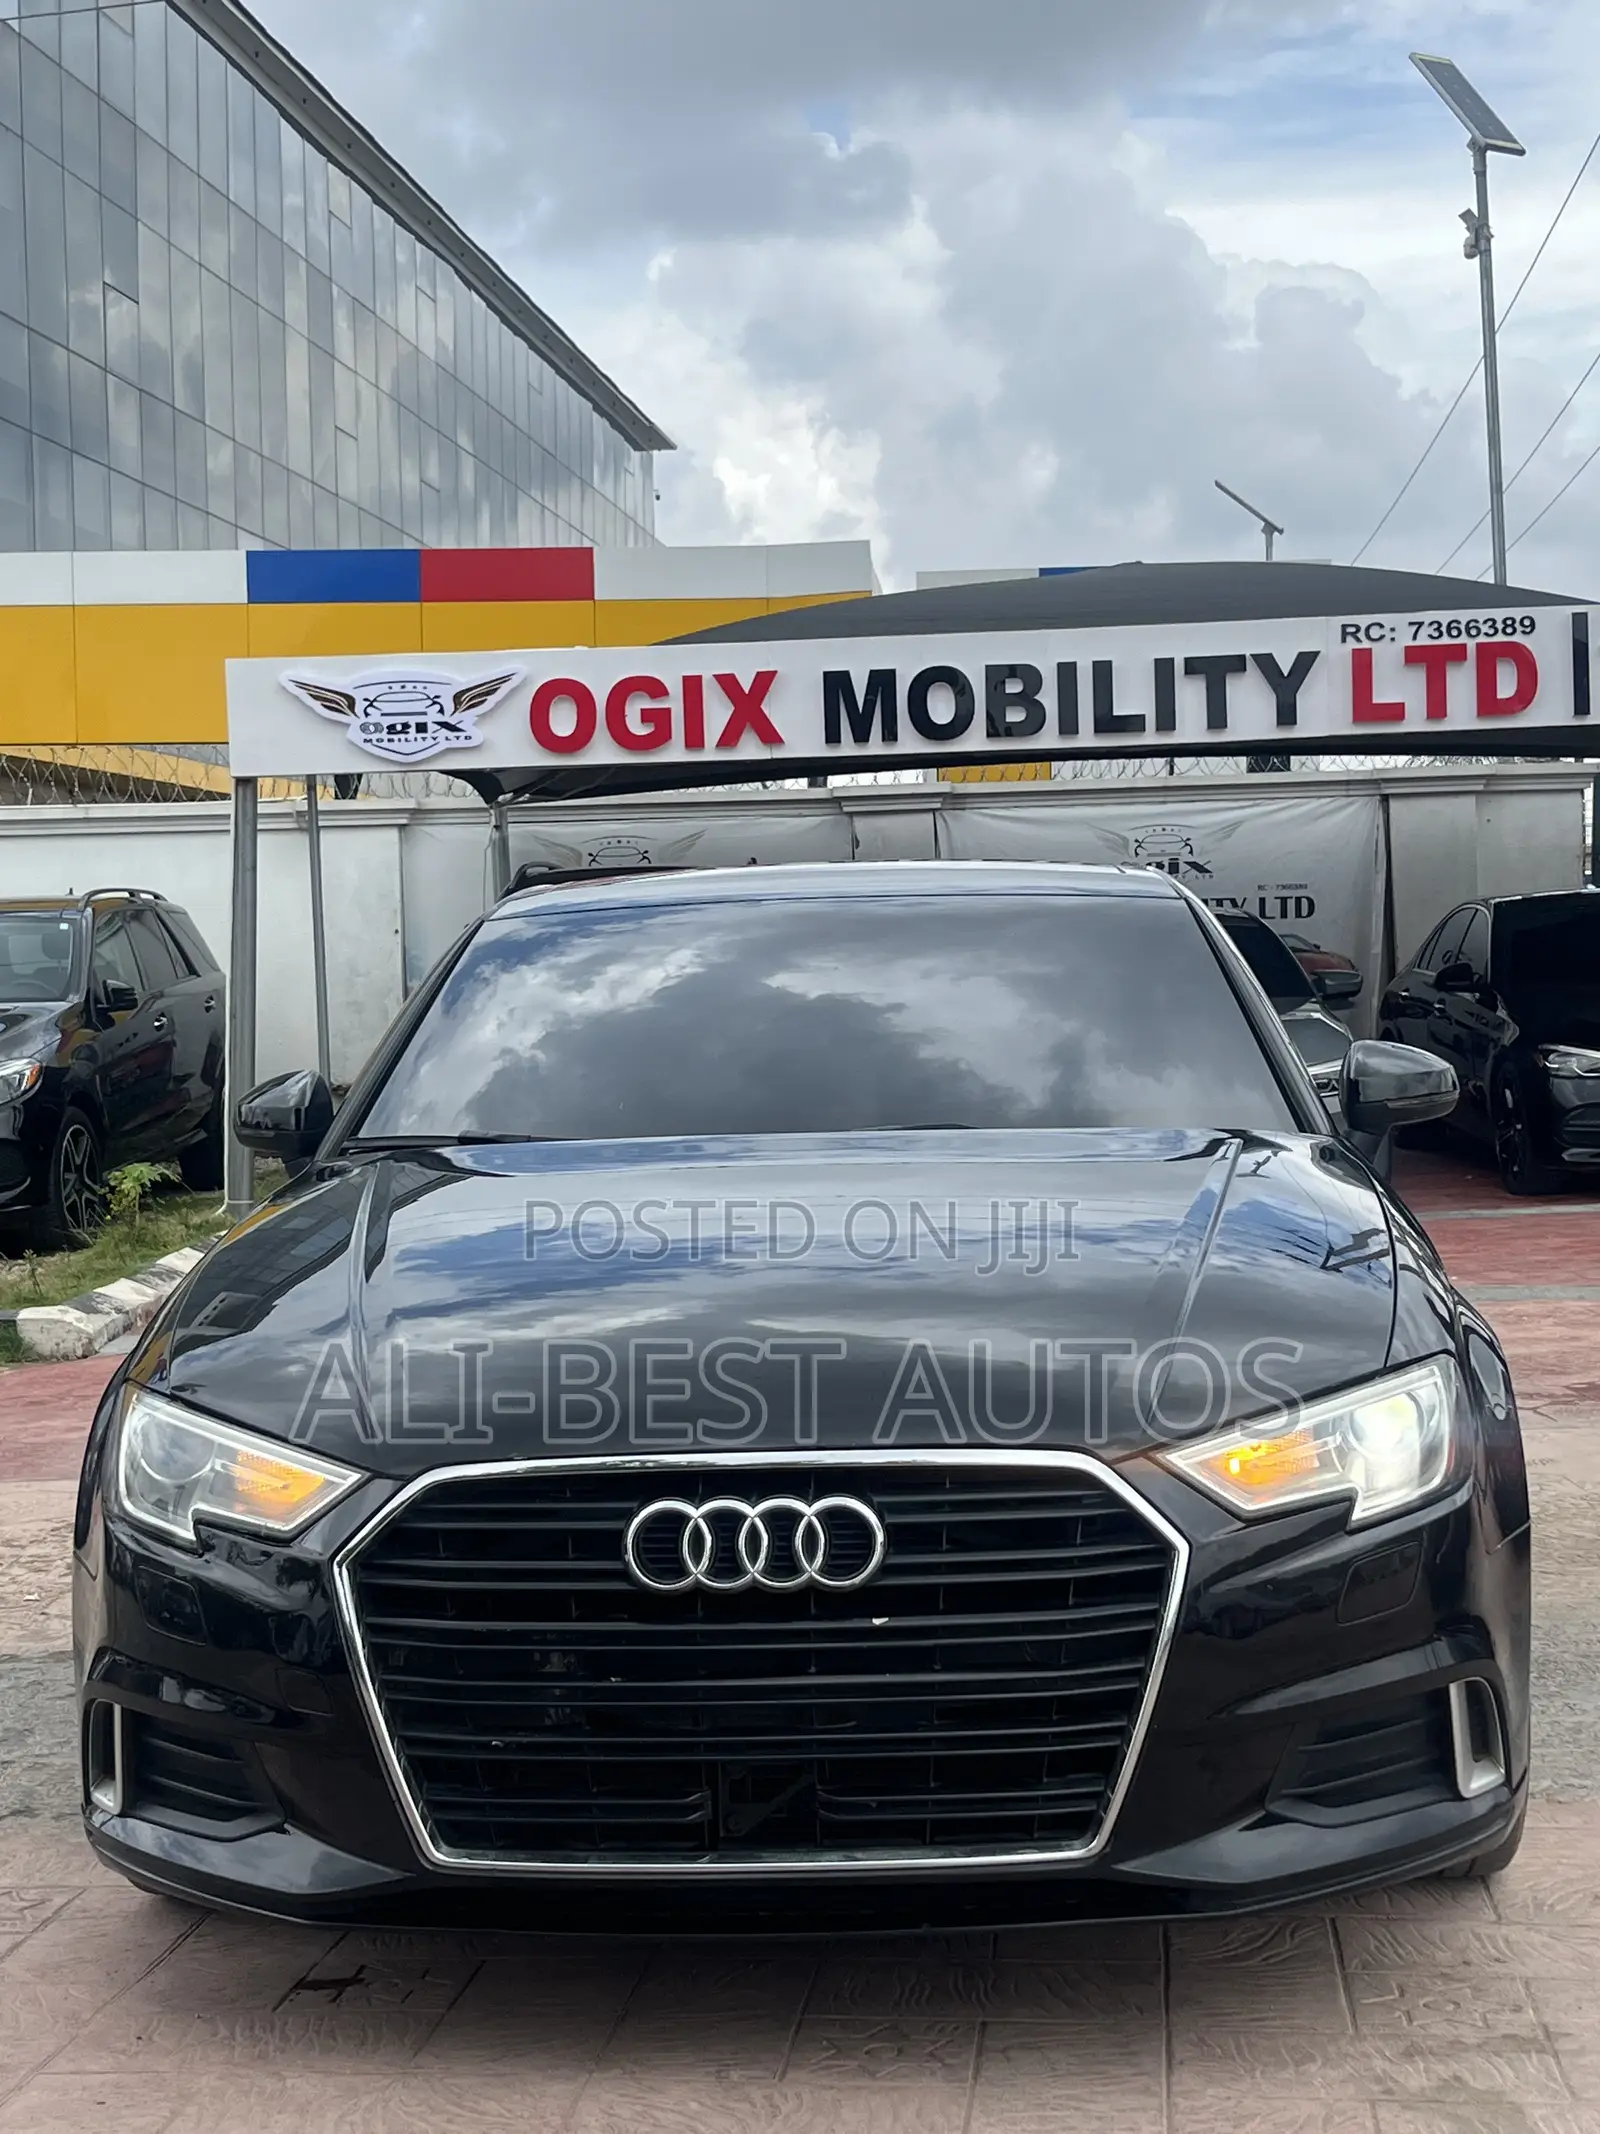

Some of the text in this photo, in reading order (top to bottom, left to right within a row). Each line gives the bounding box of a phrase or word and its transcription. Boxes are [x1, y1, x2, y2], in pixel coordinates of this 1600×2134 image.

[1340, 615, 1537, 644] RC: 7366389
[529, 640, 1540, 754] OGIX MOBILITY LTD
[1258, 895, 1316, 920] LTD
